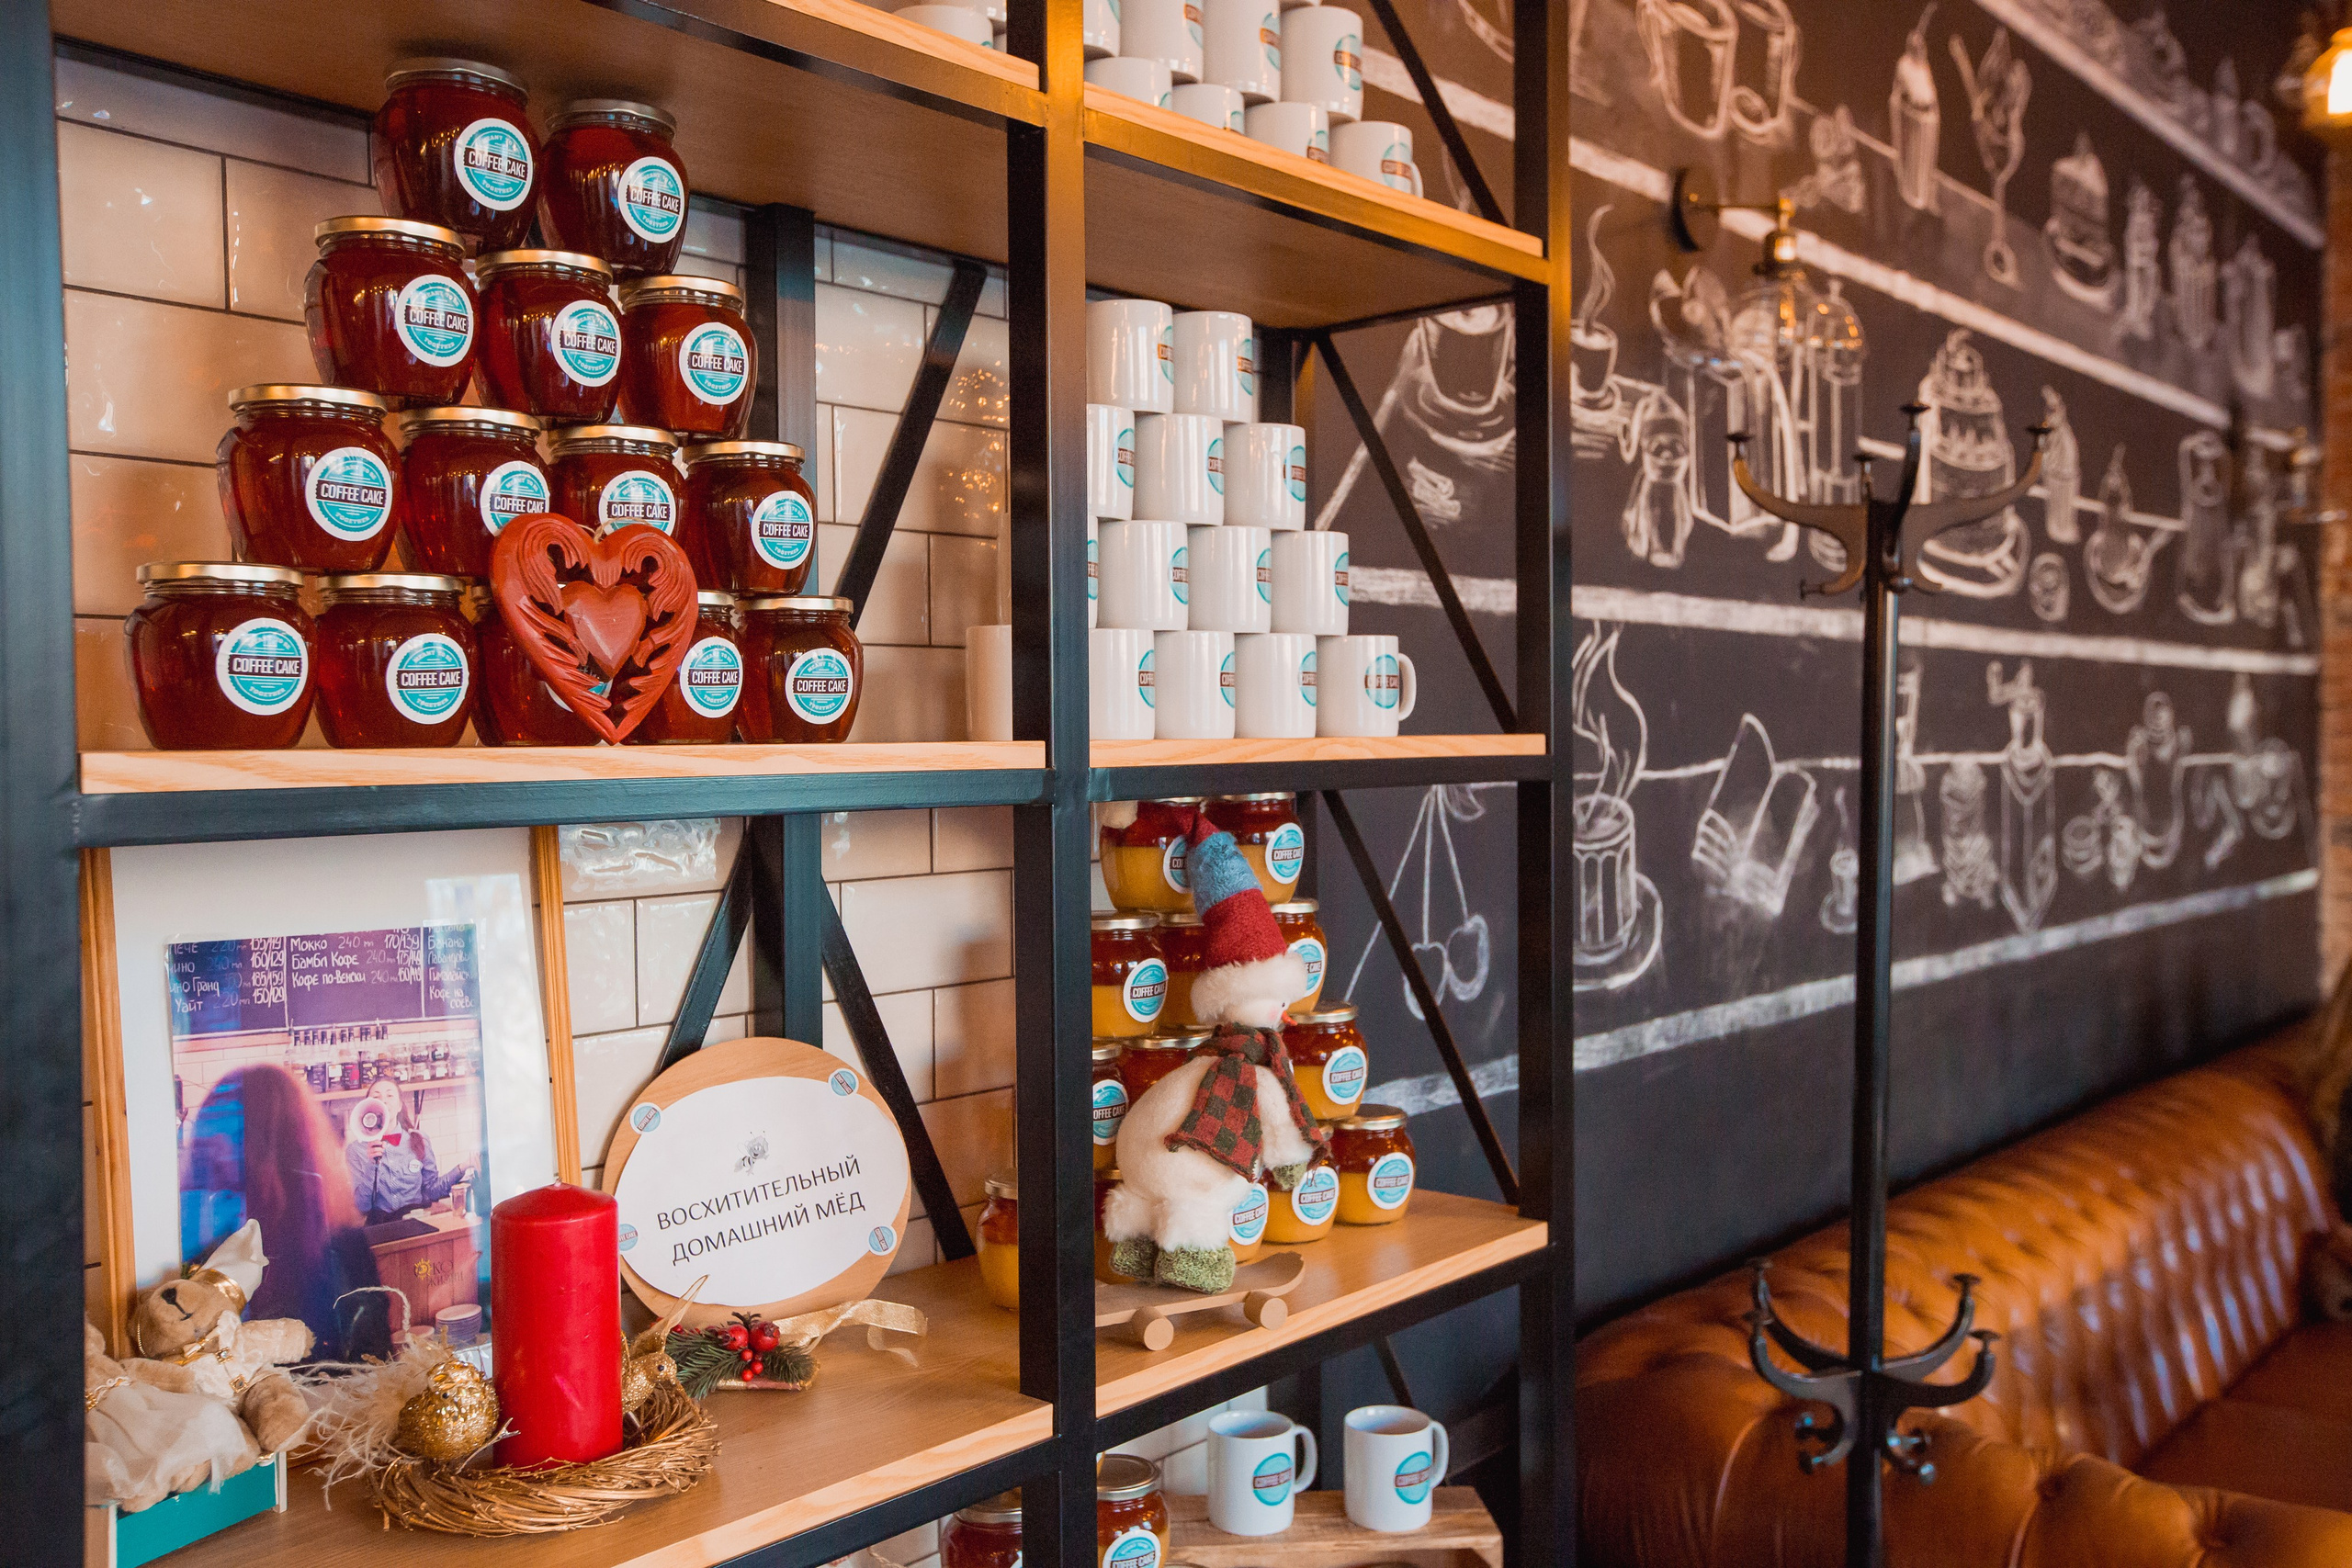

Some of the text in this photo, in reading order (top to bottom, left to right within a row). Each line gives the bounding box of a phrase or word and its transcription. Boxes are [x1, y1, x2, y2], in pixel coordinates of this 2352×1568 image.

[469, 151, 526, 178] COFFEE CAKE
[630, 186, 679, 212] COFFEE CAKE
[409, 308, 467, 332] COFFEE CAKE
[563, 333, 616, 355] COFFEE CAKE
[692, 354, 742, 373] COFFEE CAKE
[322, 482, 384, 505] COFFEE CAKE
[493, 496, 545, 513] COFFEE CAKE
[611, 503, 668, 519] COFFEE CAKE
[763, 523, 808, 537] COFFEE CAKE
[232, 658, 300, 675] COFFEE CAKE
[401, 671, 461, 687] COFFEE CAKE
[692, 670, 738, 684] COFFEE CAKE
[797, 679, 846, 693] COFFEE CAKE
[1273, 850, 1293, 861] COFFEE
[290, 937, 328, 953] Мокко
[338, 936, 361, 949] 240
[384, 933, 420, 952] 170/139
[250, 952, 284, 970] 160/129
[291, 953, 328, 970] Бамбл
[1132, 983, 1166, 998] COFFEE CAKE
[1093, 1108, 1112, 1120] OFFEE
[657, 1155, 861, 1231] ВОСХИТИТЕЛЬНЫЙ
[672, 1191, 866, 1267] ДОМАШНИЙ МЁД
